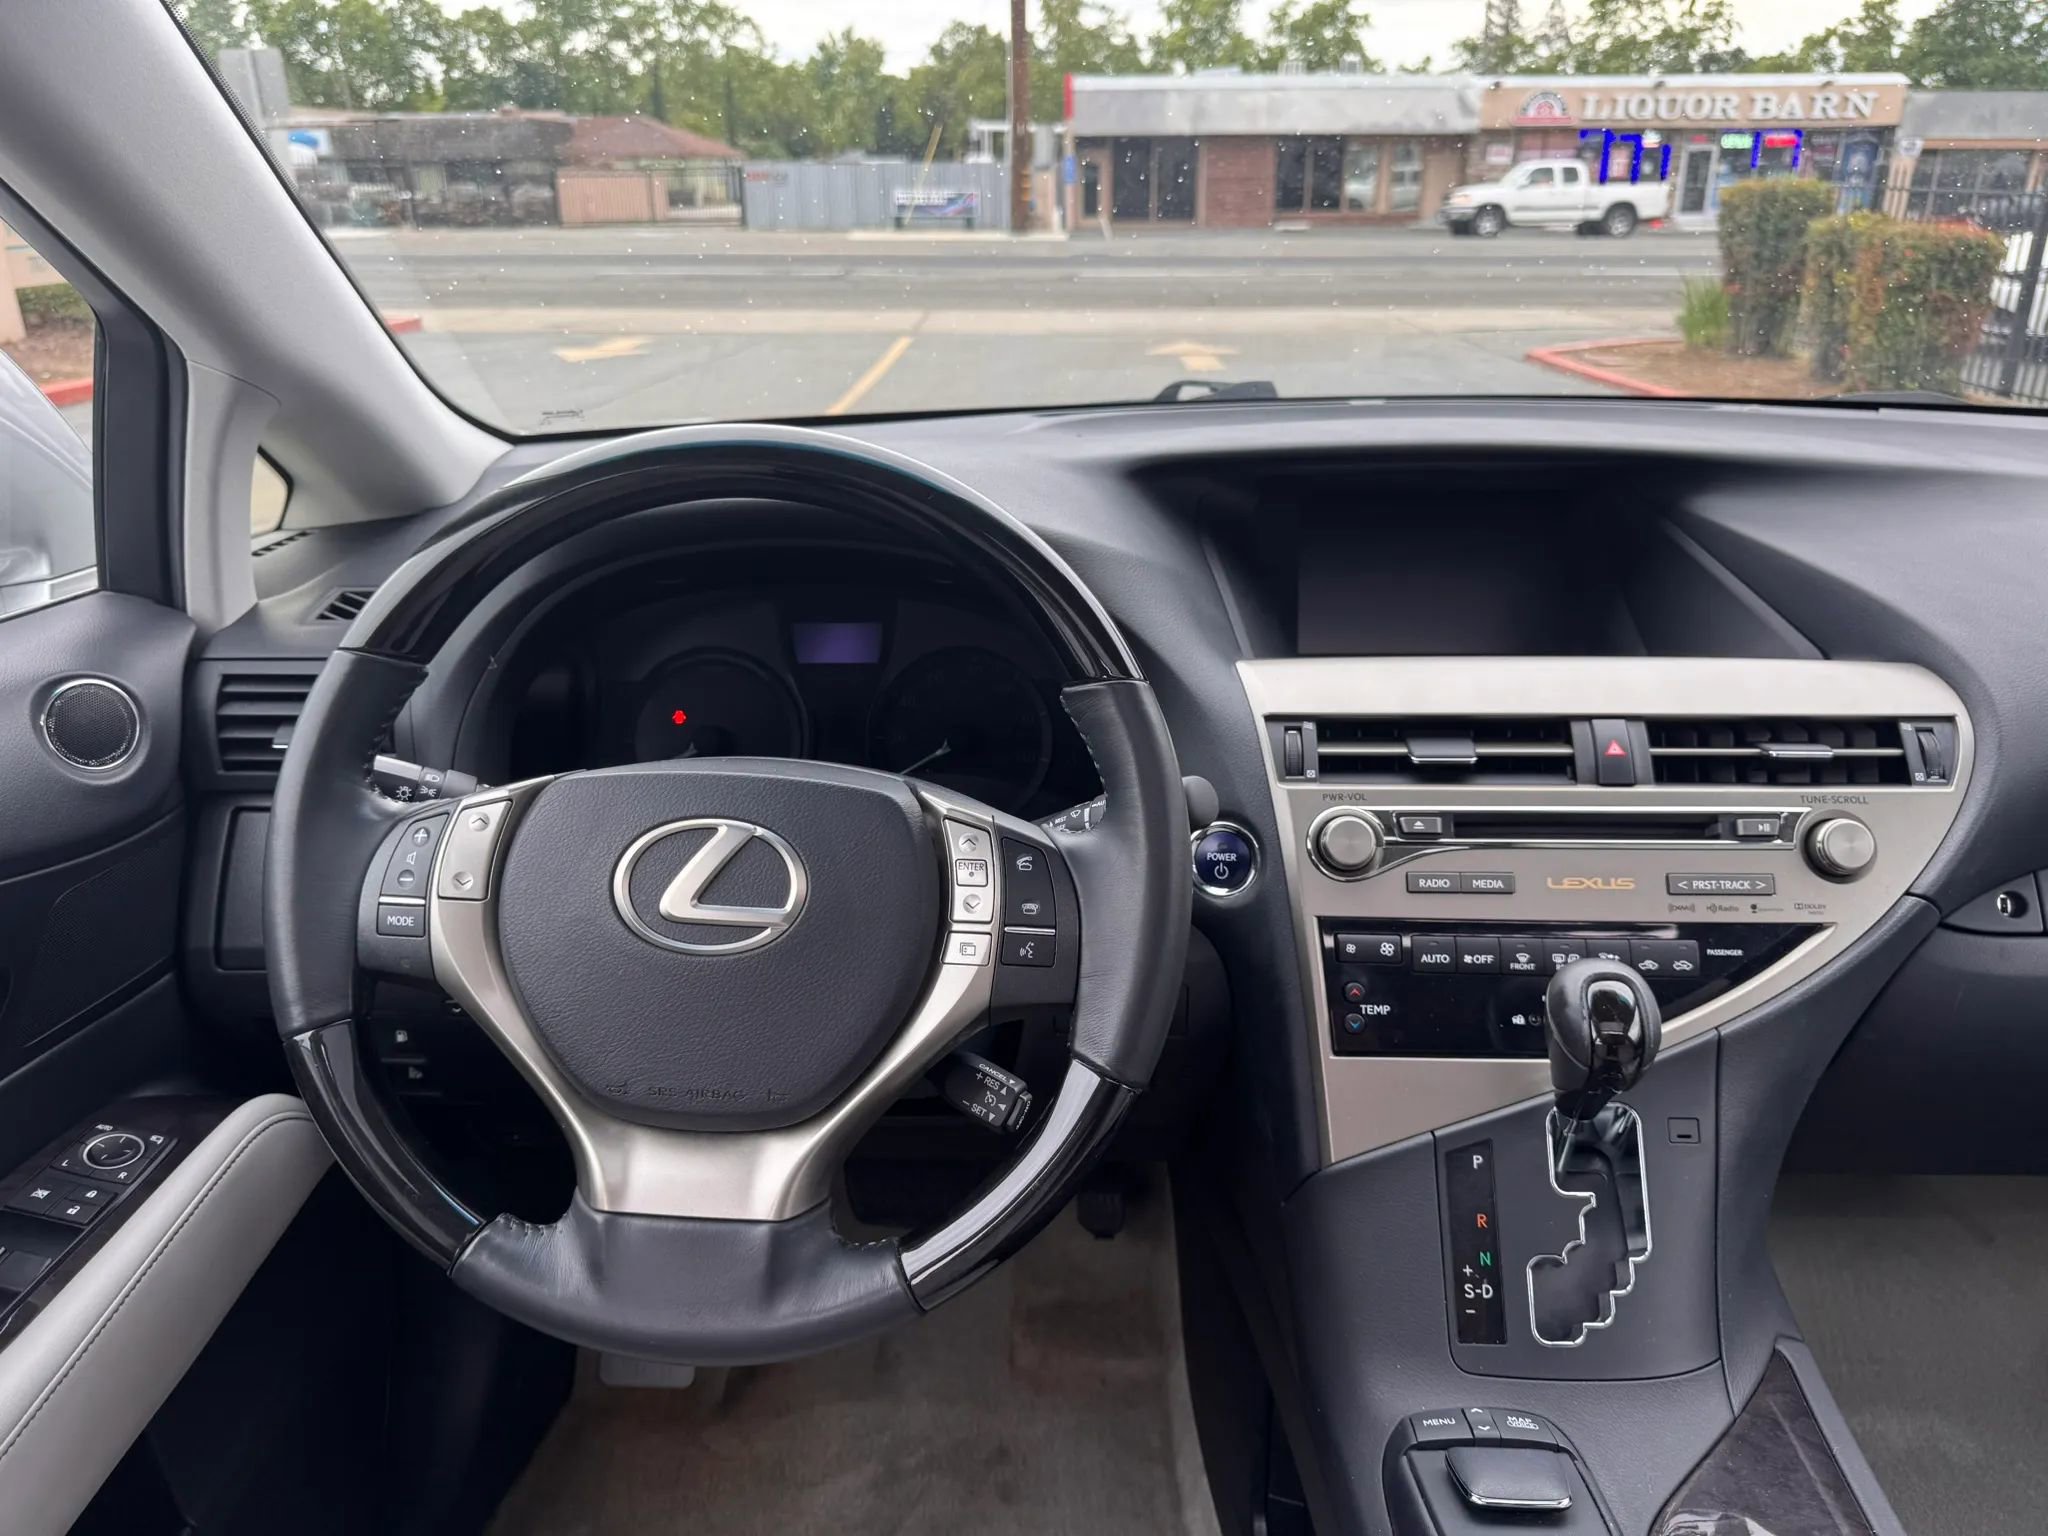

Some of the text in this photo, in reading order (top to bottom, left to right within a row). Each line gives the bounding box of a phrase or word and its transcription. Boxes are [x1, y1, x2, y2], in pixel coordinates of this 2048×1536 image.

[1582, 92, 1741, 121] LIQUOR
[1748, 91, 1880, 121] BARN
[1322, 793, 1367, 801] PWR-VOL
[1800, 795, 1869, 805] TUNE-SCROLL
[1207, 852, 1237, 862] POWER
[958, 861, 985, 871] ENTER
[1419, 878, 1450, 888] RADIO
[1472, 878, 1504, 889] MEDIA
[1547, 876, 1636, 890] LEXUS
[1692, 880, 1750, 890] PRST-TRACK
[387, 915, 415, 926] MODE
[1420, 954, 1450, 964] AUTO
[1473, 954, 1495, 964] OFF
[1360, 1004, 1391, 1015] TEMP
[979, 1063, 1007, 1082] CANCEL
[984, 1076, 1001, 1090] RES
[971, 1103, 987, 1117] SET
[1473, 1154, 1483, 1169] P
[117, 1171, 128, 1179] R
[1476, 1213, 1488, 1228] R
[1479, 1251, 1491, 1266] N
[1423, 1417, 1456, 1427] MENU
